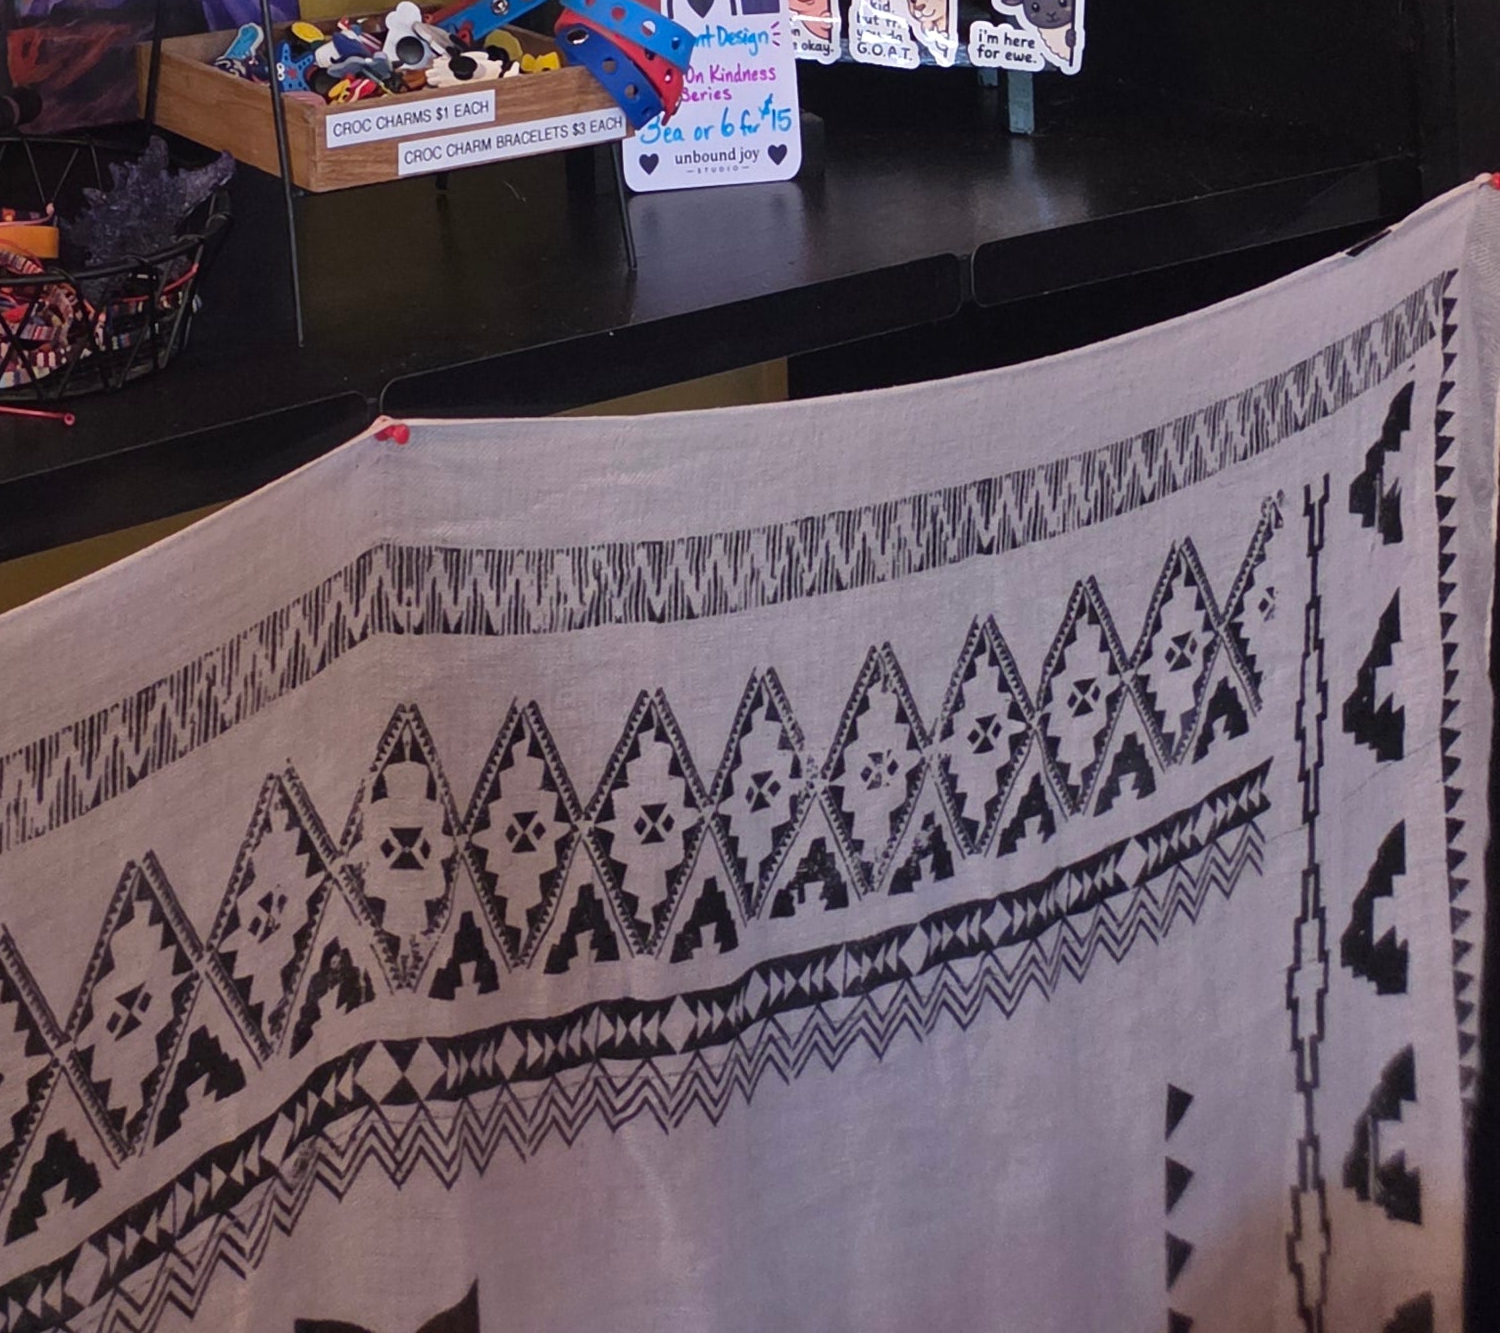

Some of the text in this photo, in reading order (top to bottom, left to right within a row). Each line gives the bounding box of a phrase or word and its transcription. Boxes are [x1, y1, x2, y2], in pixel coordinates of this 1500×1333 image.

[717, 25, 769, 56] Design
[801, 41, 834, 56] okay.
[978, 28, 1035, 49] i'm here
[977, 44, 1037, 64] for ewe.
[685, 63, 776, 84] On Kindness
[332, 100, 489, 138] CROC CHARMS $1 EACH
[694, 124, 715, 141] or
[721, 106, 735, 138] 6
[740, 110, 761, 136] for
[404, 115, 623, 165] CROC CHARM BRACELETS $3 EACH
[675, 147, 760, 165] unbound joy
